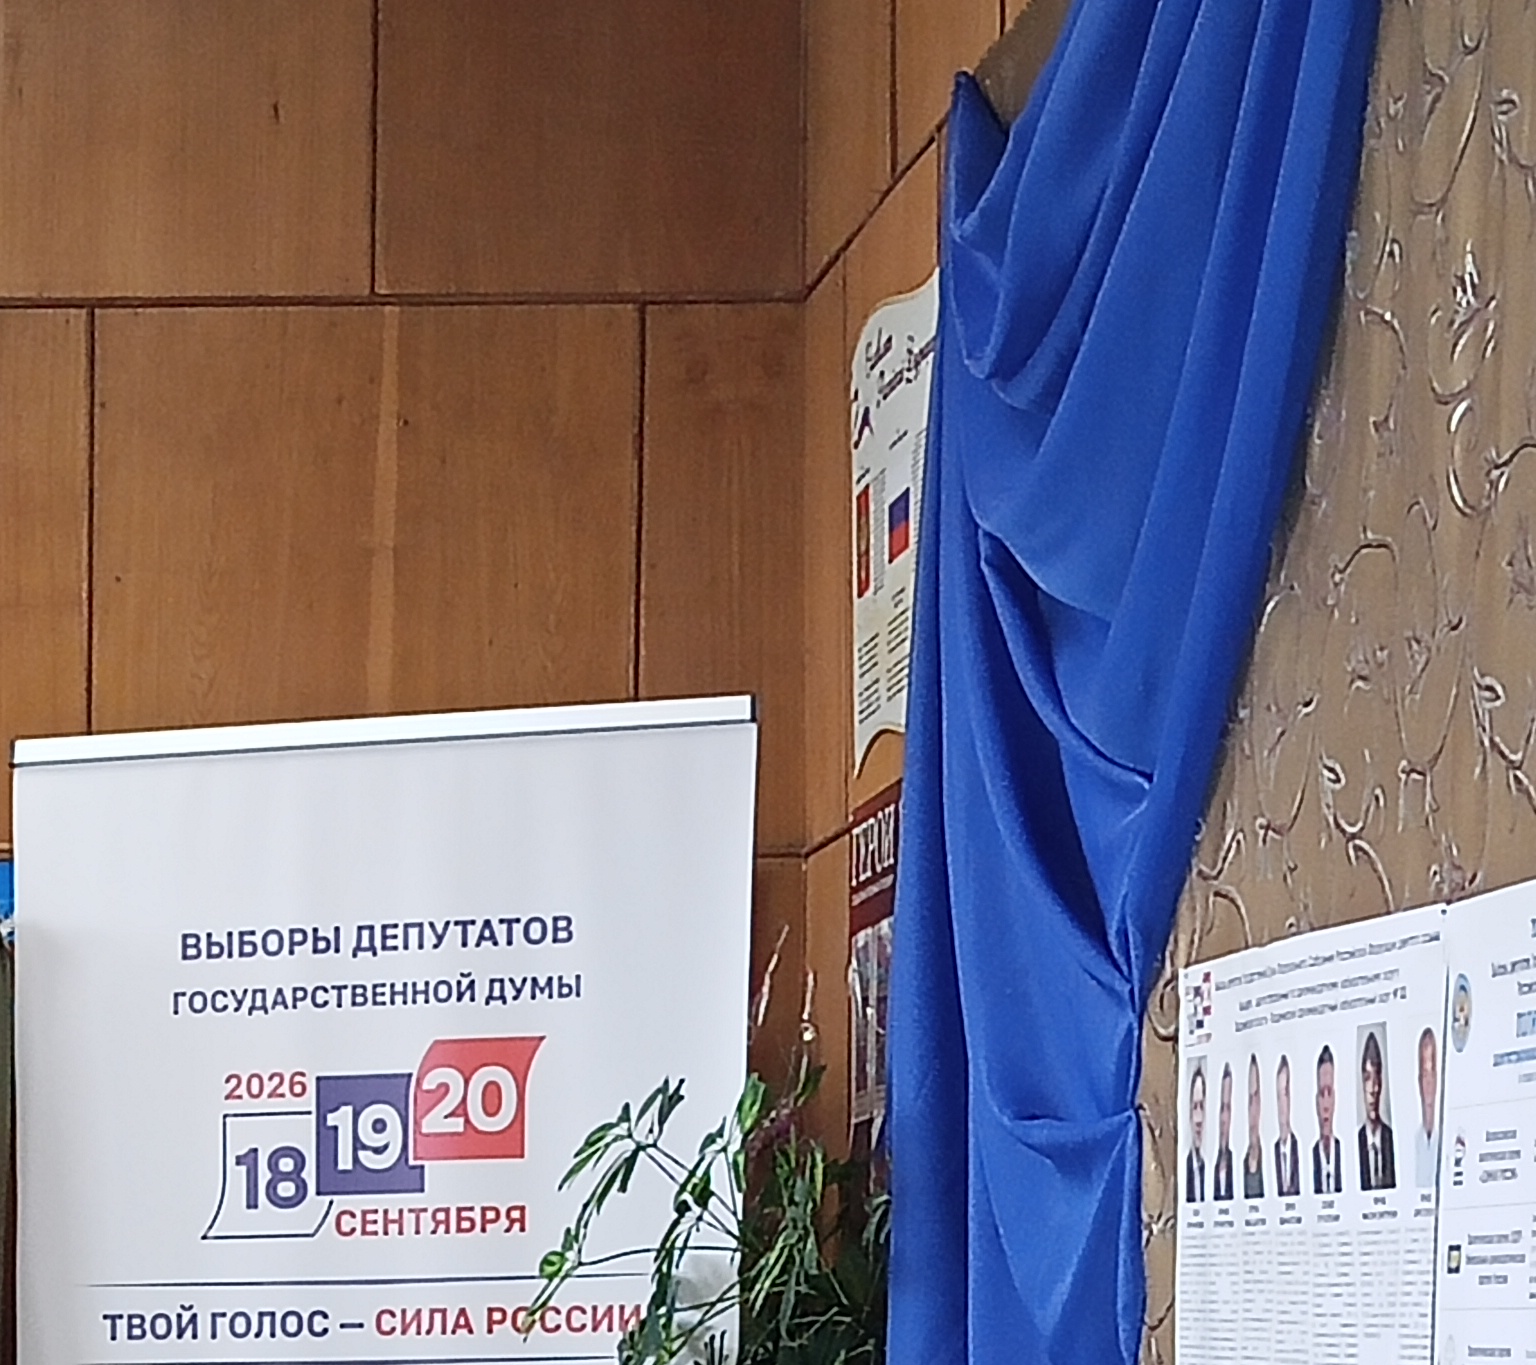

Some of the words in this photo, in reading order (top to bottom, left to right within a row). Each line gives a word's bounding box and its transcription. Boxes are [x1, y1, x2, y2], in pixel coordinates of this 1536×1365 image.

[180, 925, 342, 961] ВЫБОРЫ
[351, 914, 575, 958] ДЕПУТАТОВ
[172, 971, 477, 1016] ГОСУДАРСТВЕННОЙ
[484, 973, 582, 1004] ДУМЫ
[224, 1071, 308, 1101] 2026
[235, 1146, 308, 1210] 18
[325, 1103, 403, 1171] 19
[419, 1065, 516, 1133] 20
[334, 1204, 527, 1238] СЕНТЯБРЯ
[103, 1304, 200, 1342] ТВОЙ
[210, 1310, 330, 1340] ГОЛОС
[375, 1306, 474, 1336] СИЛА
